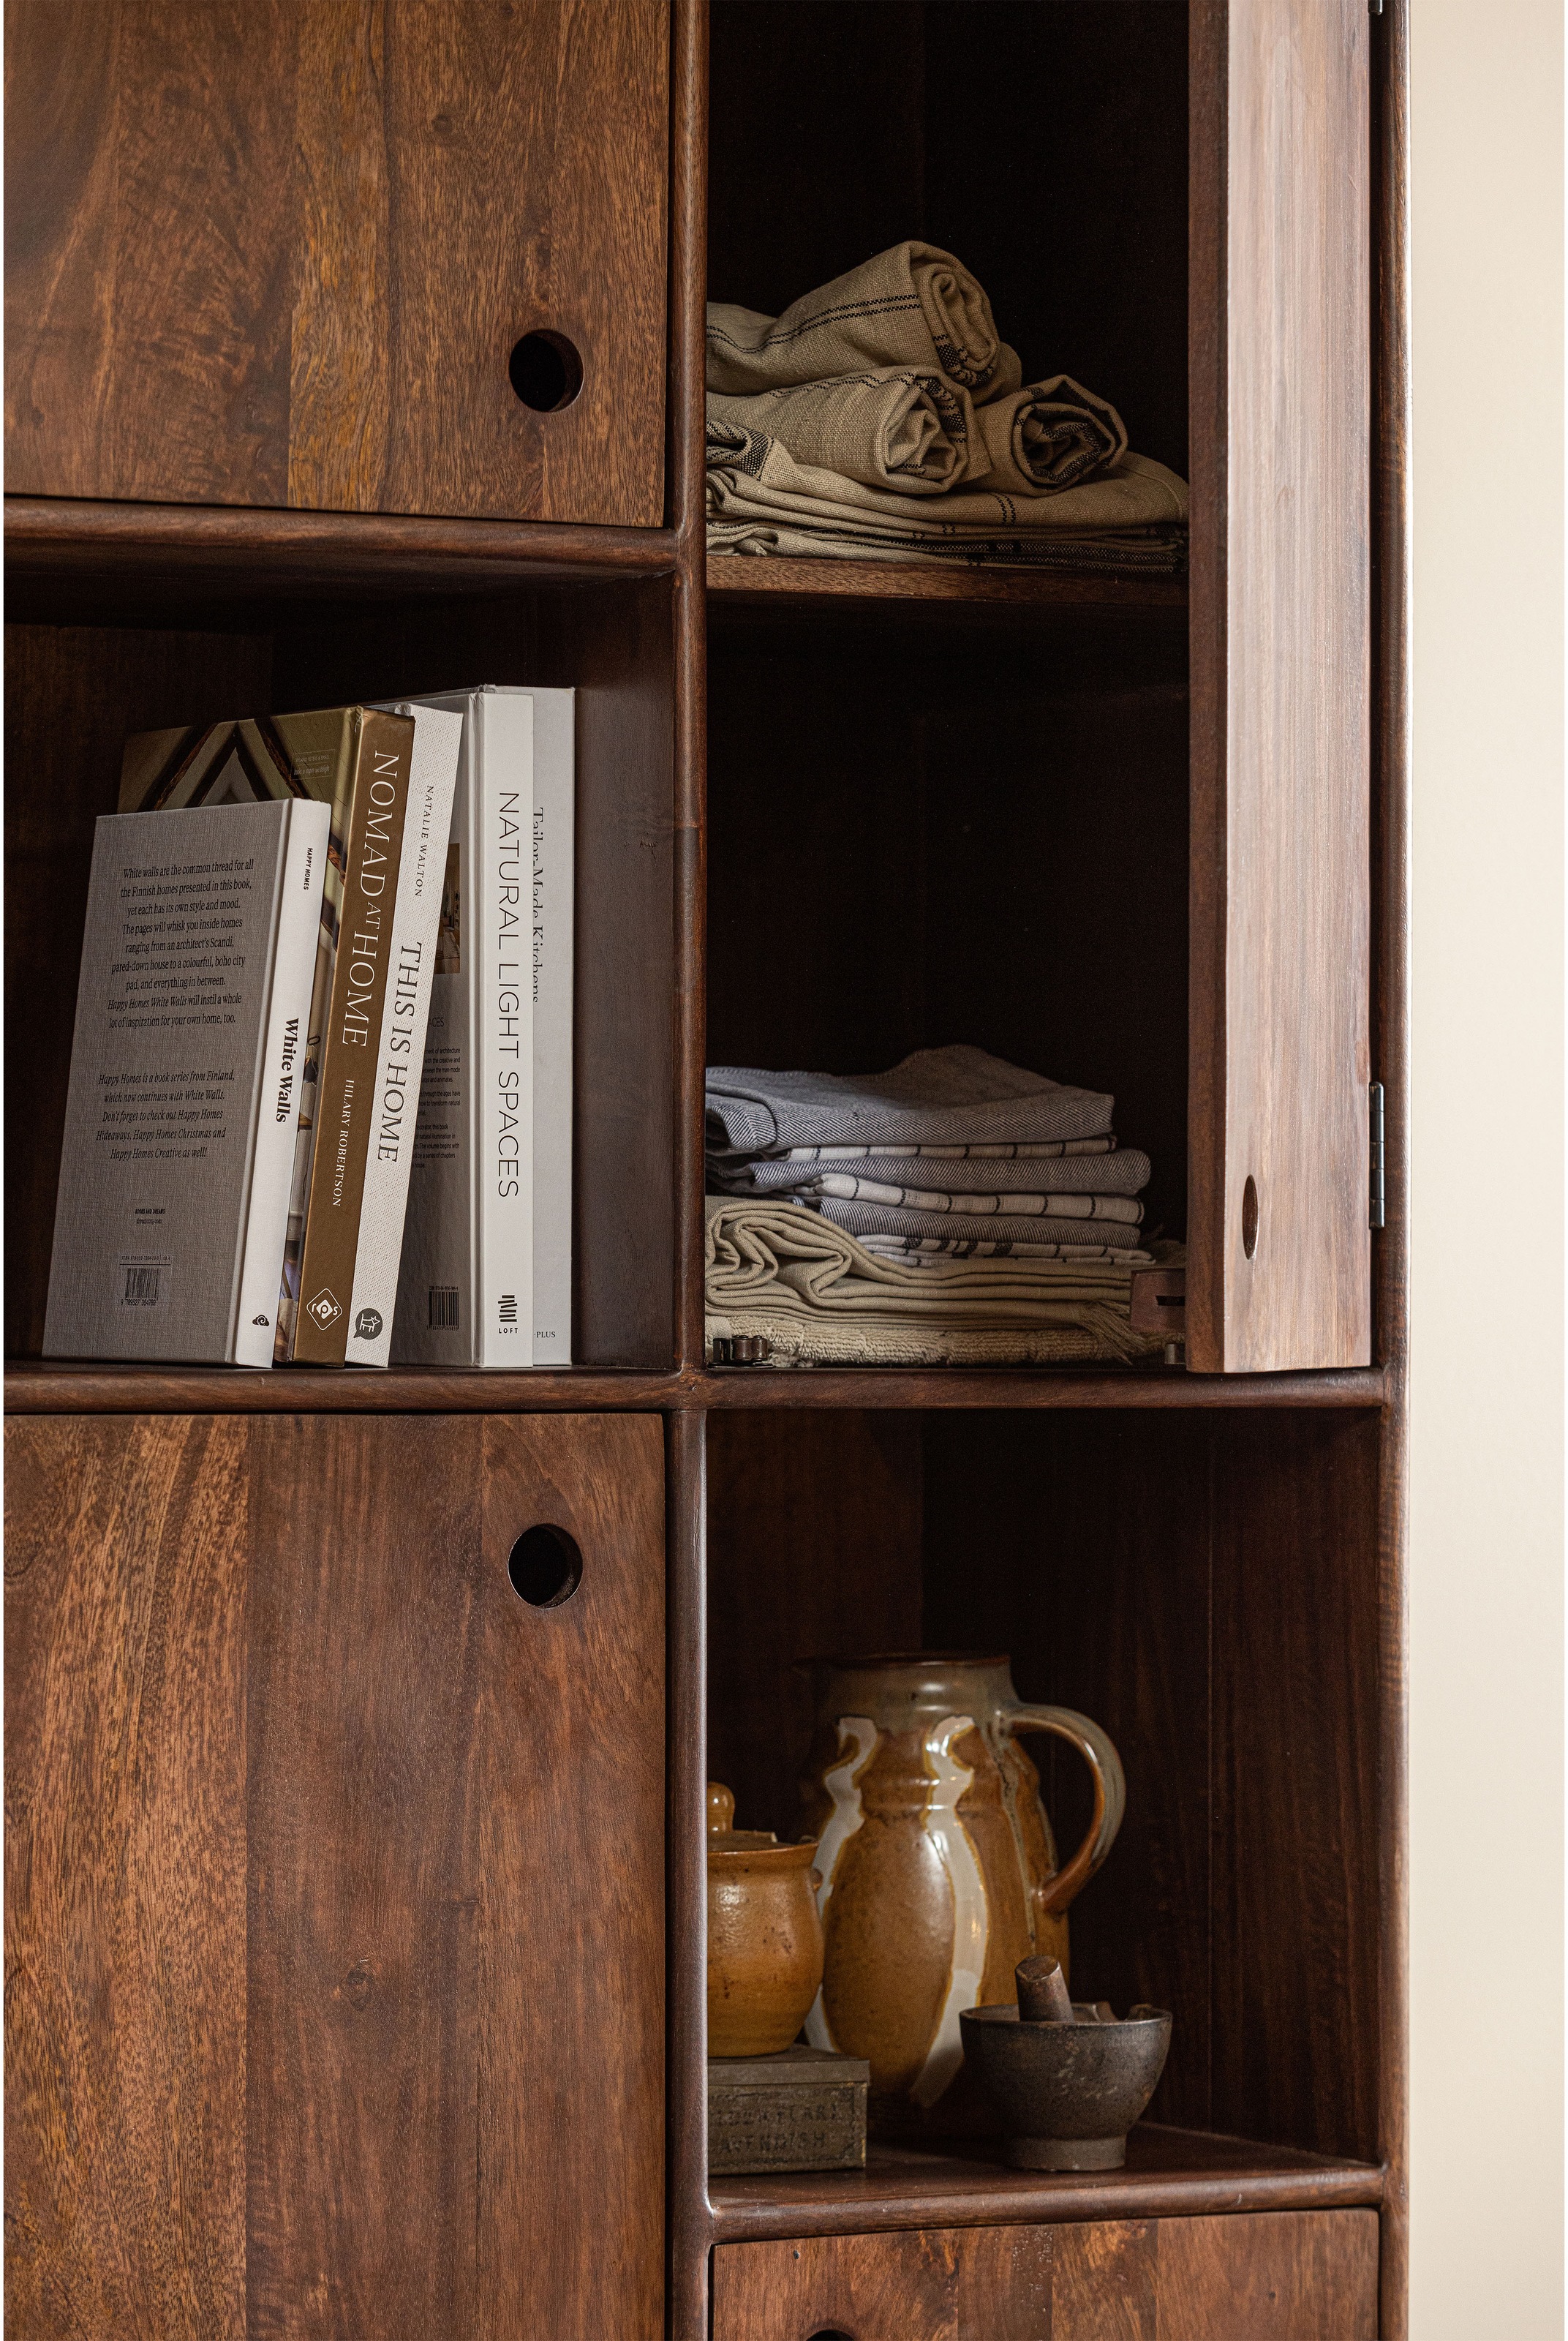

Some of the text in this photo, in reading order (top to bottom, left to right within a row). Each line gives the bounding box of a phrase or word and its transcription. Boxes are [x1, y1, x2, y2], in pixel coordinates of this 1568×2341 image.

[415, 786, 434, 897] NATALIE WALTON
[123, 858, 254, 878] White walls are the common thread for all
[121, 887, 131, 898] the
[132, 884, 155, 896] Finnish
[157, 884, 178, 895] homes
[178, 881, 211, 895] presented
[211, 880, 219, 891] in
[219, 879, 233, 890] this
[127, 906, 137, 918] yet
[137, 903, 153, 914] each
[154, 903, 165, 914] has
[165, 902, 174, 913] its
[174, 903, 189, 912] own
[189, 900, 205, 913] style
[206, 898, 219, 910] and
[342, 750, 399, 1047] NOMAD AT HOME
[122, 917, 243, 936] The pages will whisk you inside homes
[125, 944, 149, 955] ranging
[151, 940, 165, 951] from
[167, 942, 176, 950] an
[111, 961, 148, 974] pared-down
[150, 959, 169, 970] house
[170, 960, 176, 969] to
[177, 960, 181, 969] a
[215, 955, 231, 966] boho
[233, 954, 246, 967] city
[140, 978, 153, 989] and
[154, 977, 188, 990] everything
[189, 976, 195, 986] in
[108, 992, 242, 1011] Happy Homes White Walls will instil a whole
[498, 793, 519, 1197] NATURAL LIGHT SPACES
[108, 1017, 118, 1028] lot
[118, 1016, 126, 1027] of
[126, 1015, 159, 1029] inspiration
[160, 1015, 170, 1026] for
[170, 1017, 186, 1028] your
[186, 1016, 200, 1024] own
[377, 942, 423, 1162] THIS IS HOME
[98, 1074, 118, 1086] Happy
[120, 1073, 141, 1083] Homes
[142, 1072, 148, 1083] is
[148, 1075, 154, 1083] a
[154, 1071, 170, 1082] book
[170, 1071, 189, 1082] series
[188, 1070, 206, 1083] from
[276, 1018, 298, 1123] White Walls
[104, 1092, 122, 1102] which
[123, 1094, 136, 1102] now
[137, 1091, 167, 1102] continues
[169, 1090, 183, 1100] with
[185, 1089, 204, 1100] White
[118, 1111, 138, 1123] forget
[139, 1112, 146, 1121] to
[146, 1109, 165, 1120] check
[165, 1111, 176, 1120] out
[177, 1109, 200, 1121] Happy
[200, 1108, 223, 1119] Homes
[132, 1130, 154, 1141] Happy
[155, 1129, 177, 1139] Homes
[178, 1128, 211, 1138] Christmas
[212, 1127, 227, 1138] and
[332, 1079, 354, 1206] HILARY ROBERTSON
[110, 1149, 132, 1161] Happy
[132, 1148, 154, 1158] Homes
[154, 1148, 181, 1158] Creative
[182, 1149, 190, 1157] as
